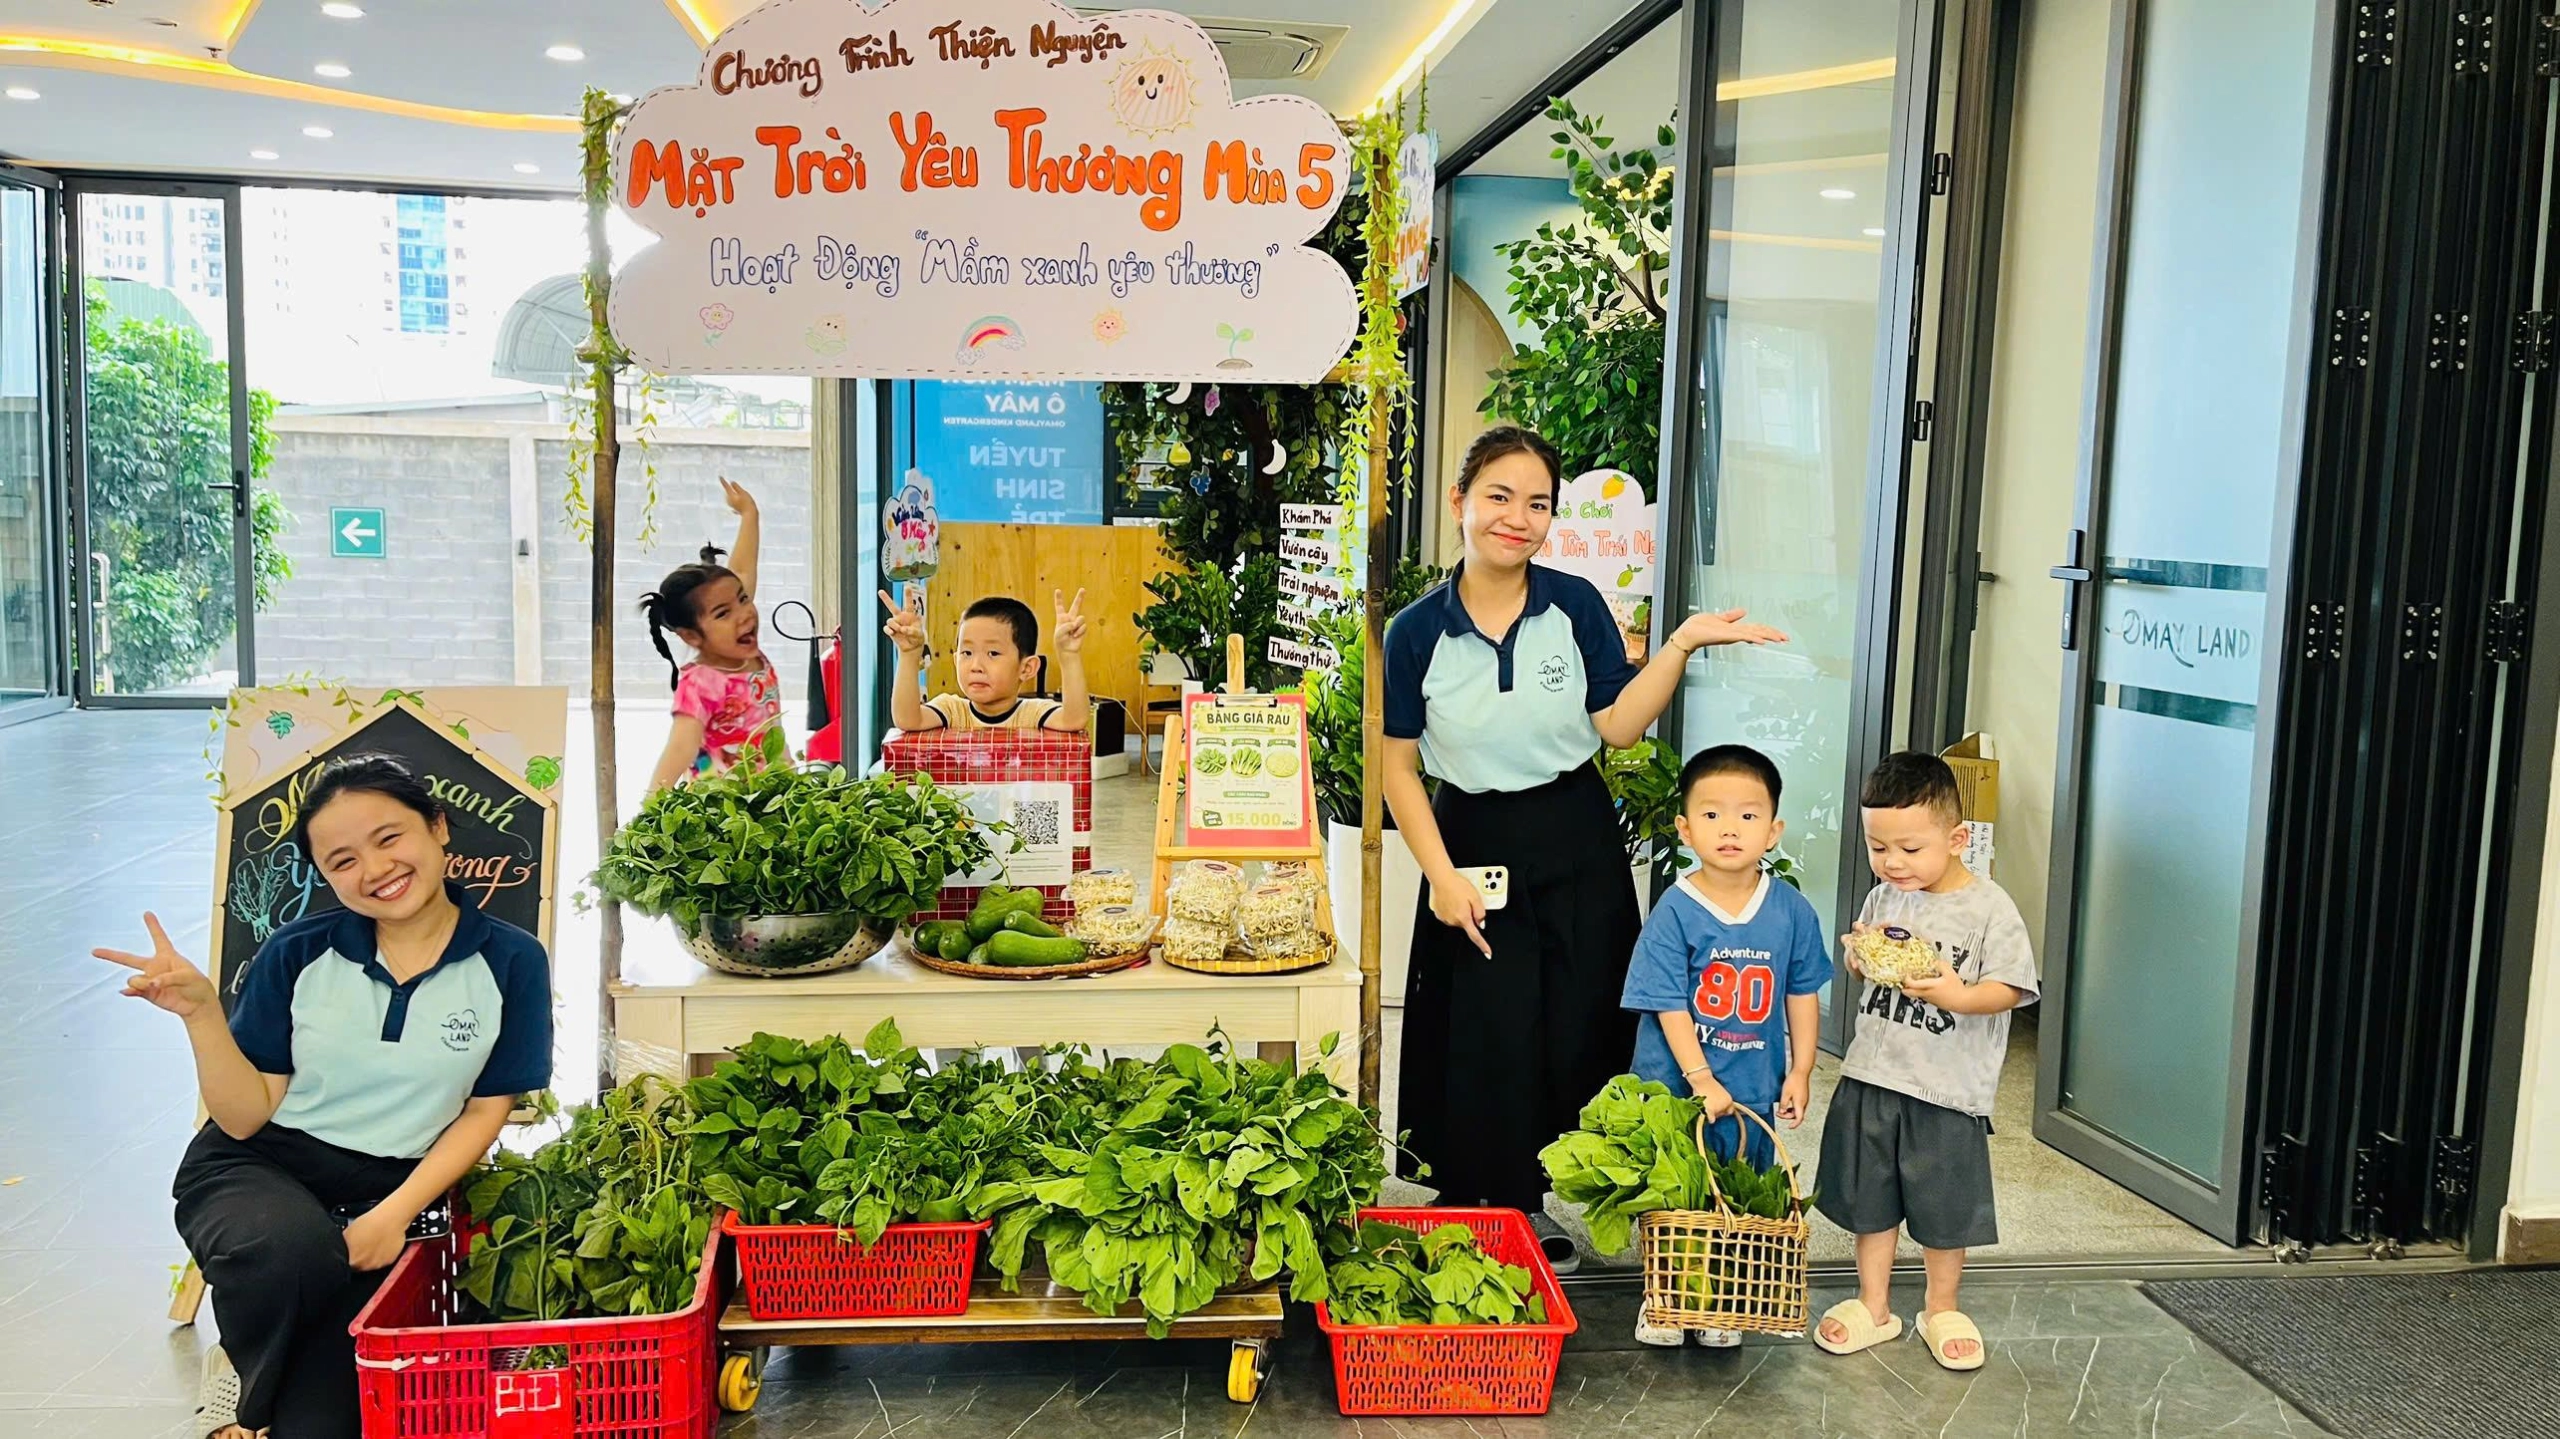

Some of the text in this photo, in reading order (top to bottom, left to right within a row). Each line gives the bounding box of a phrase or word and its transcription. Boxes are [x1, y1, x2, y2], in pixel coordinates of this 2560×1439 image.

[711, 20, 1127, 98] Chương Trình Thiện Nguyện
[755, 126, 867, 198] Trời
[889, 111, 978, 192] Yêu
[994, 108, 1183, 231] Thương
[1203, 140, 1287, 205] Mùa
[1296, 142, 1335, 210] 5
[710, 237, 800, 293] Hoạt
[814, 236, 900, 298] Động
[1021, 242, 1098, 286] xanh
[1108, 251, 1155, 298] yêu
[1282, 508, 1332, 525] Khám Phá
[1579, 500, 1614, 519] Chơi
[1308, 547, 1329, 565] cây
[1594, 530, 1628, 557] Trái
[1301, 580, 1339, 601] nghiệm
[2198, 625, 2250, 658] LAND
[1207, 710, 1291, 725] BẢNG GIÁ RAU
[424, 774, 532, 860] xanh
[1227, 812, 1282, 826] 15.000
[1693, 961, 1774, 1024] 80
